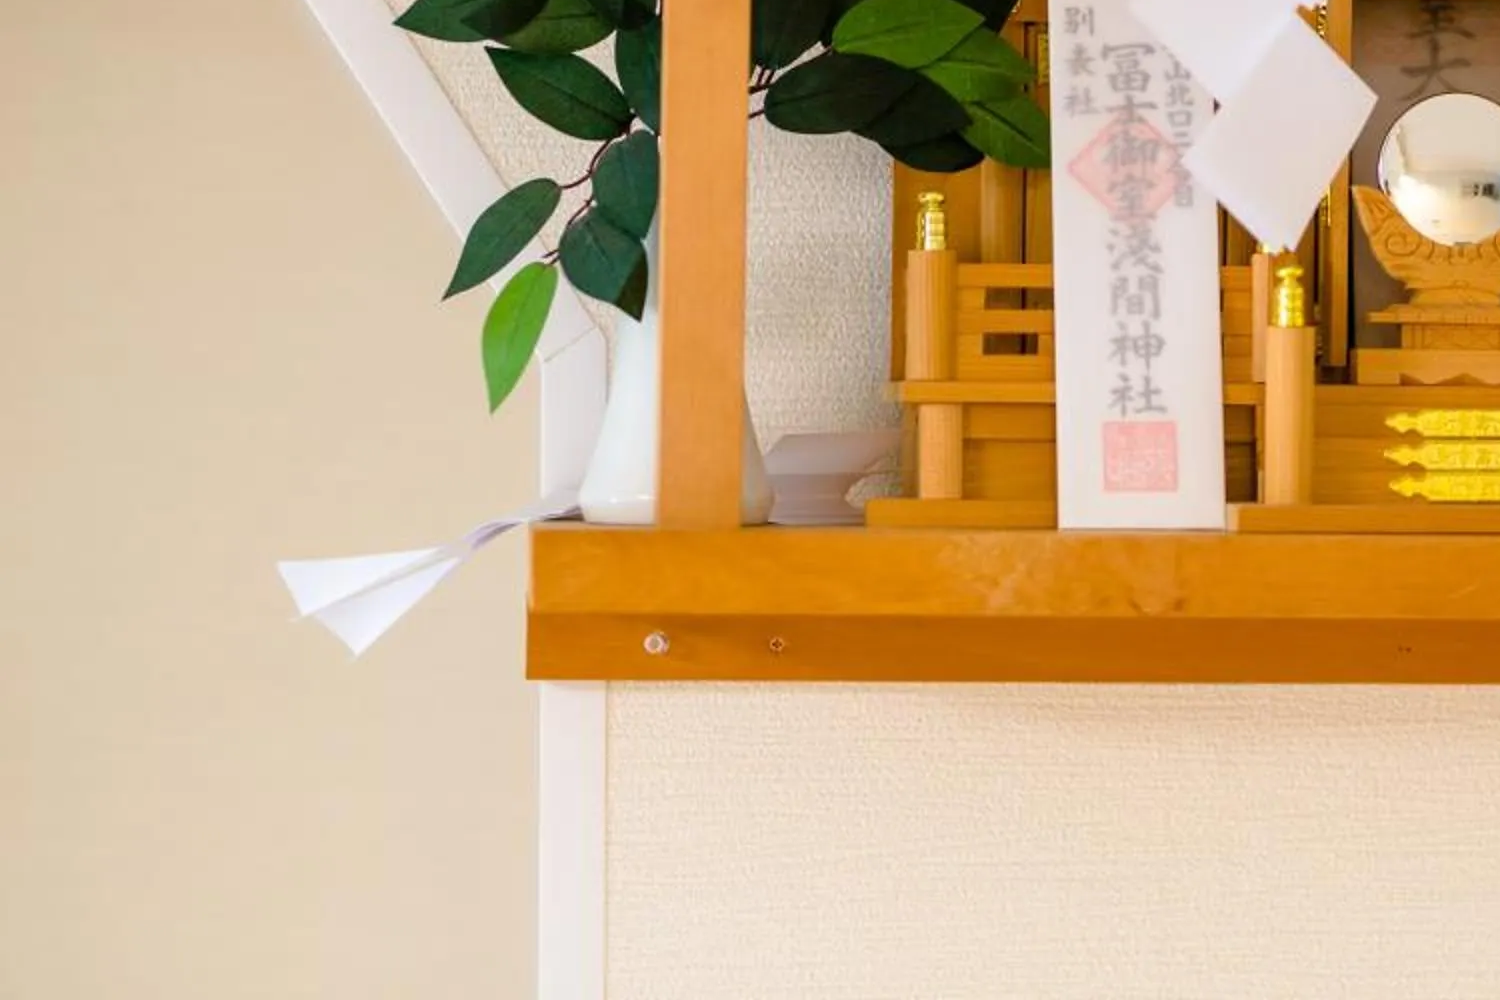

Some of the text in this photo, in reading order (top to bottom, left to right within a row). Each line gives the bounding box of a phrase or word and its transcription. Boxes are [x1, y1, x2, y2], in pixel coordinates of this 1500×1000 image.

[1160, 44, 1195, 208] 山北口二合目
